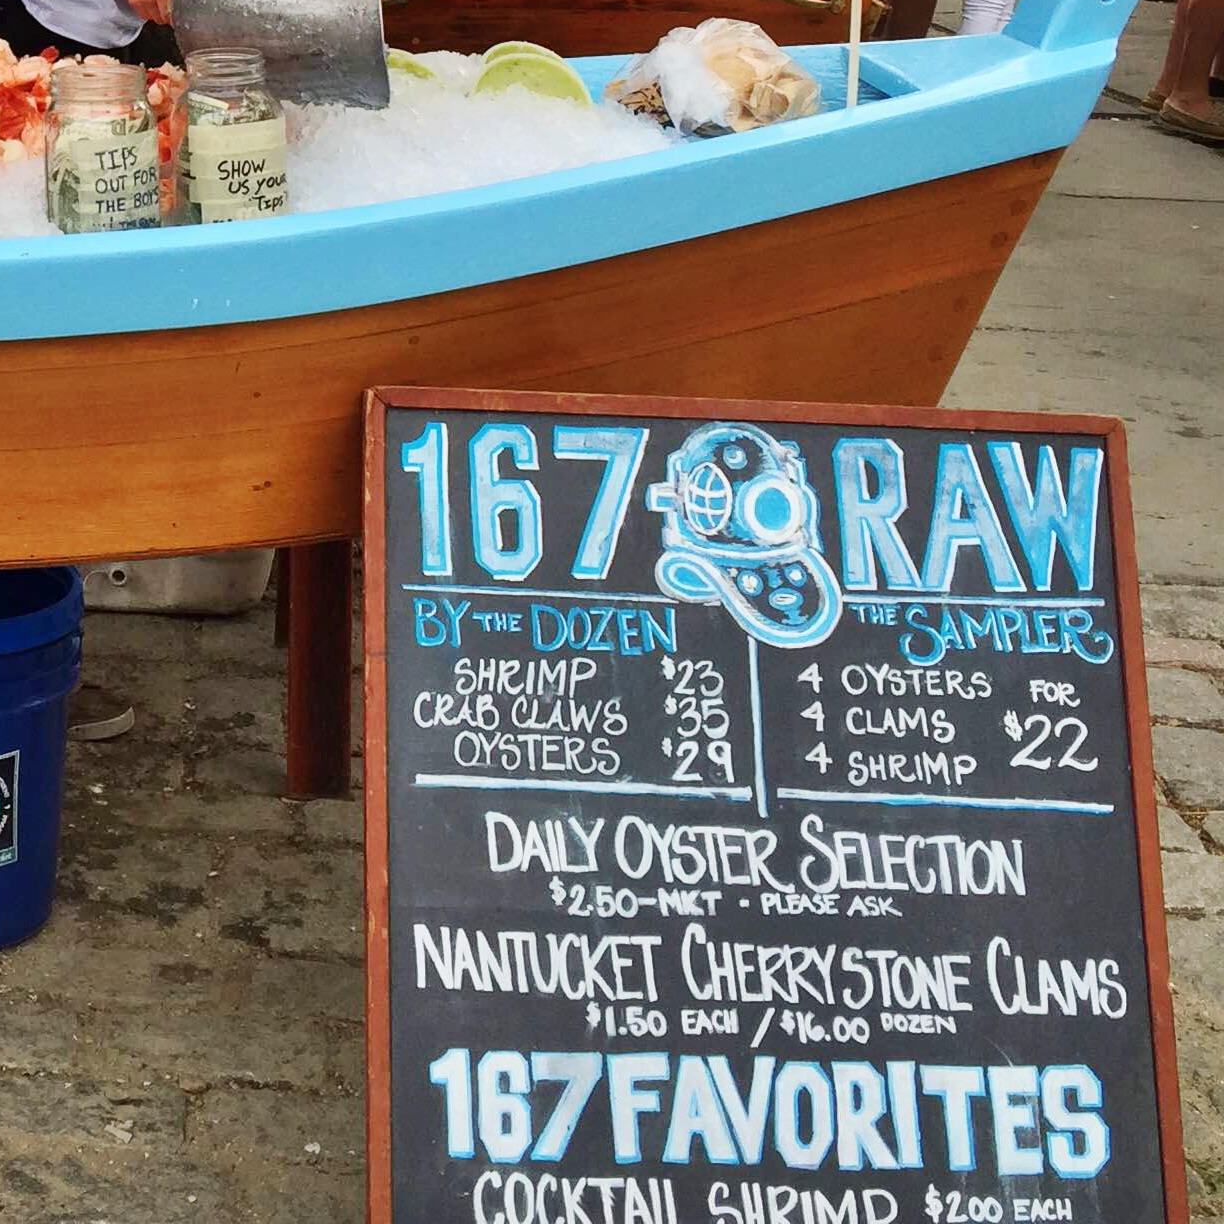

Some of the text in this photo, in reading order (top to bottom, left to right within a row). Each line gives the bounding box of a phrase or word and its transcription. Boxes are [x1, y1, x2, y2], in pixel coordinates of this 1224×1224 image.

[95, 146, 137, 170] TIPS
[218, 158, 265, 180] SHOW
[95, 167, 156, 194] OUT FOR
[228, 179, 250, 195] US
[95, 198, 126, 213] THE
[402, 422, 1104, 591] 167 RAW
[414, 597, 677, 655] BY THE DOZEN
[851, 603, 1113, 666] THE SAMPLER
[453, 655, 724, 697] SHRIMP $23
[798, 664, 991, 699] 4 OYSTERS
[1030, 678, 1081, 708] FOR
[414, 692, 729, 739] CRAB CLAWS $35
[799, 701, 956, 740] 4 CLAMS
[453, 731, 735, 783] OYSTERS $29
[1003, 712, 1099, 771] $22
[806, 742, 977, 786] 4 SHRIMP
[486, 812, 1027, 897] DAILY OYSTER SELECTION
[760, 893, 841, 916] PLEASE
[846, 896, 903, 917] ASK
[412, 922, 1128, 1019] NANTUCKET CHERRYSTONE CLAMS
[585, 1000, 667, 1037] $1.50
[681, 1008, 739, 1035] EACH
[779, 1009, 871, 1045] $16.00
[882, 1010, 957, 1035] DOZEN
[605, 1052, 1112, 1181] FAVORITES
[707, 1181, 899, 1224] SHRIMP
[1013, 1198, 1072, 1222] EACH
